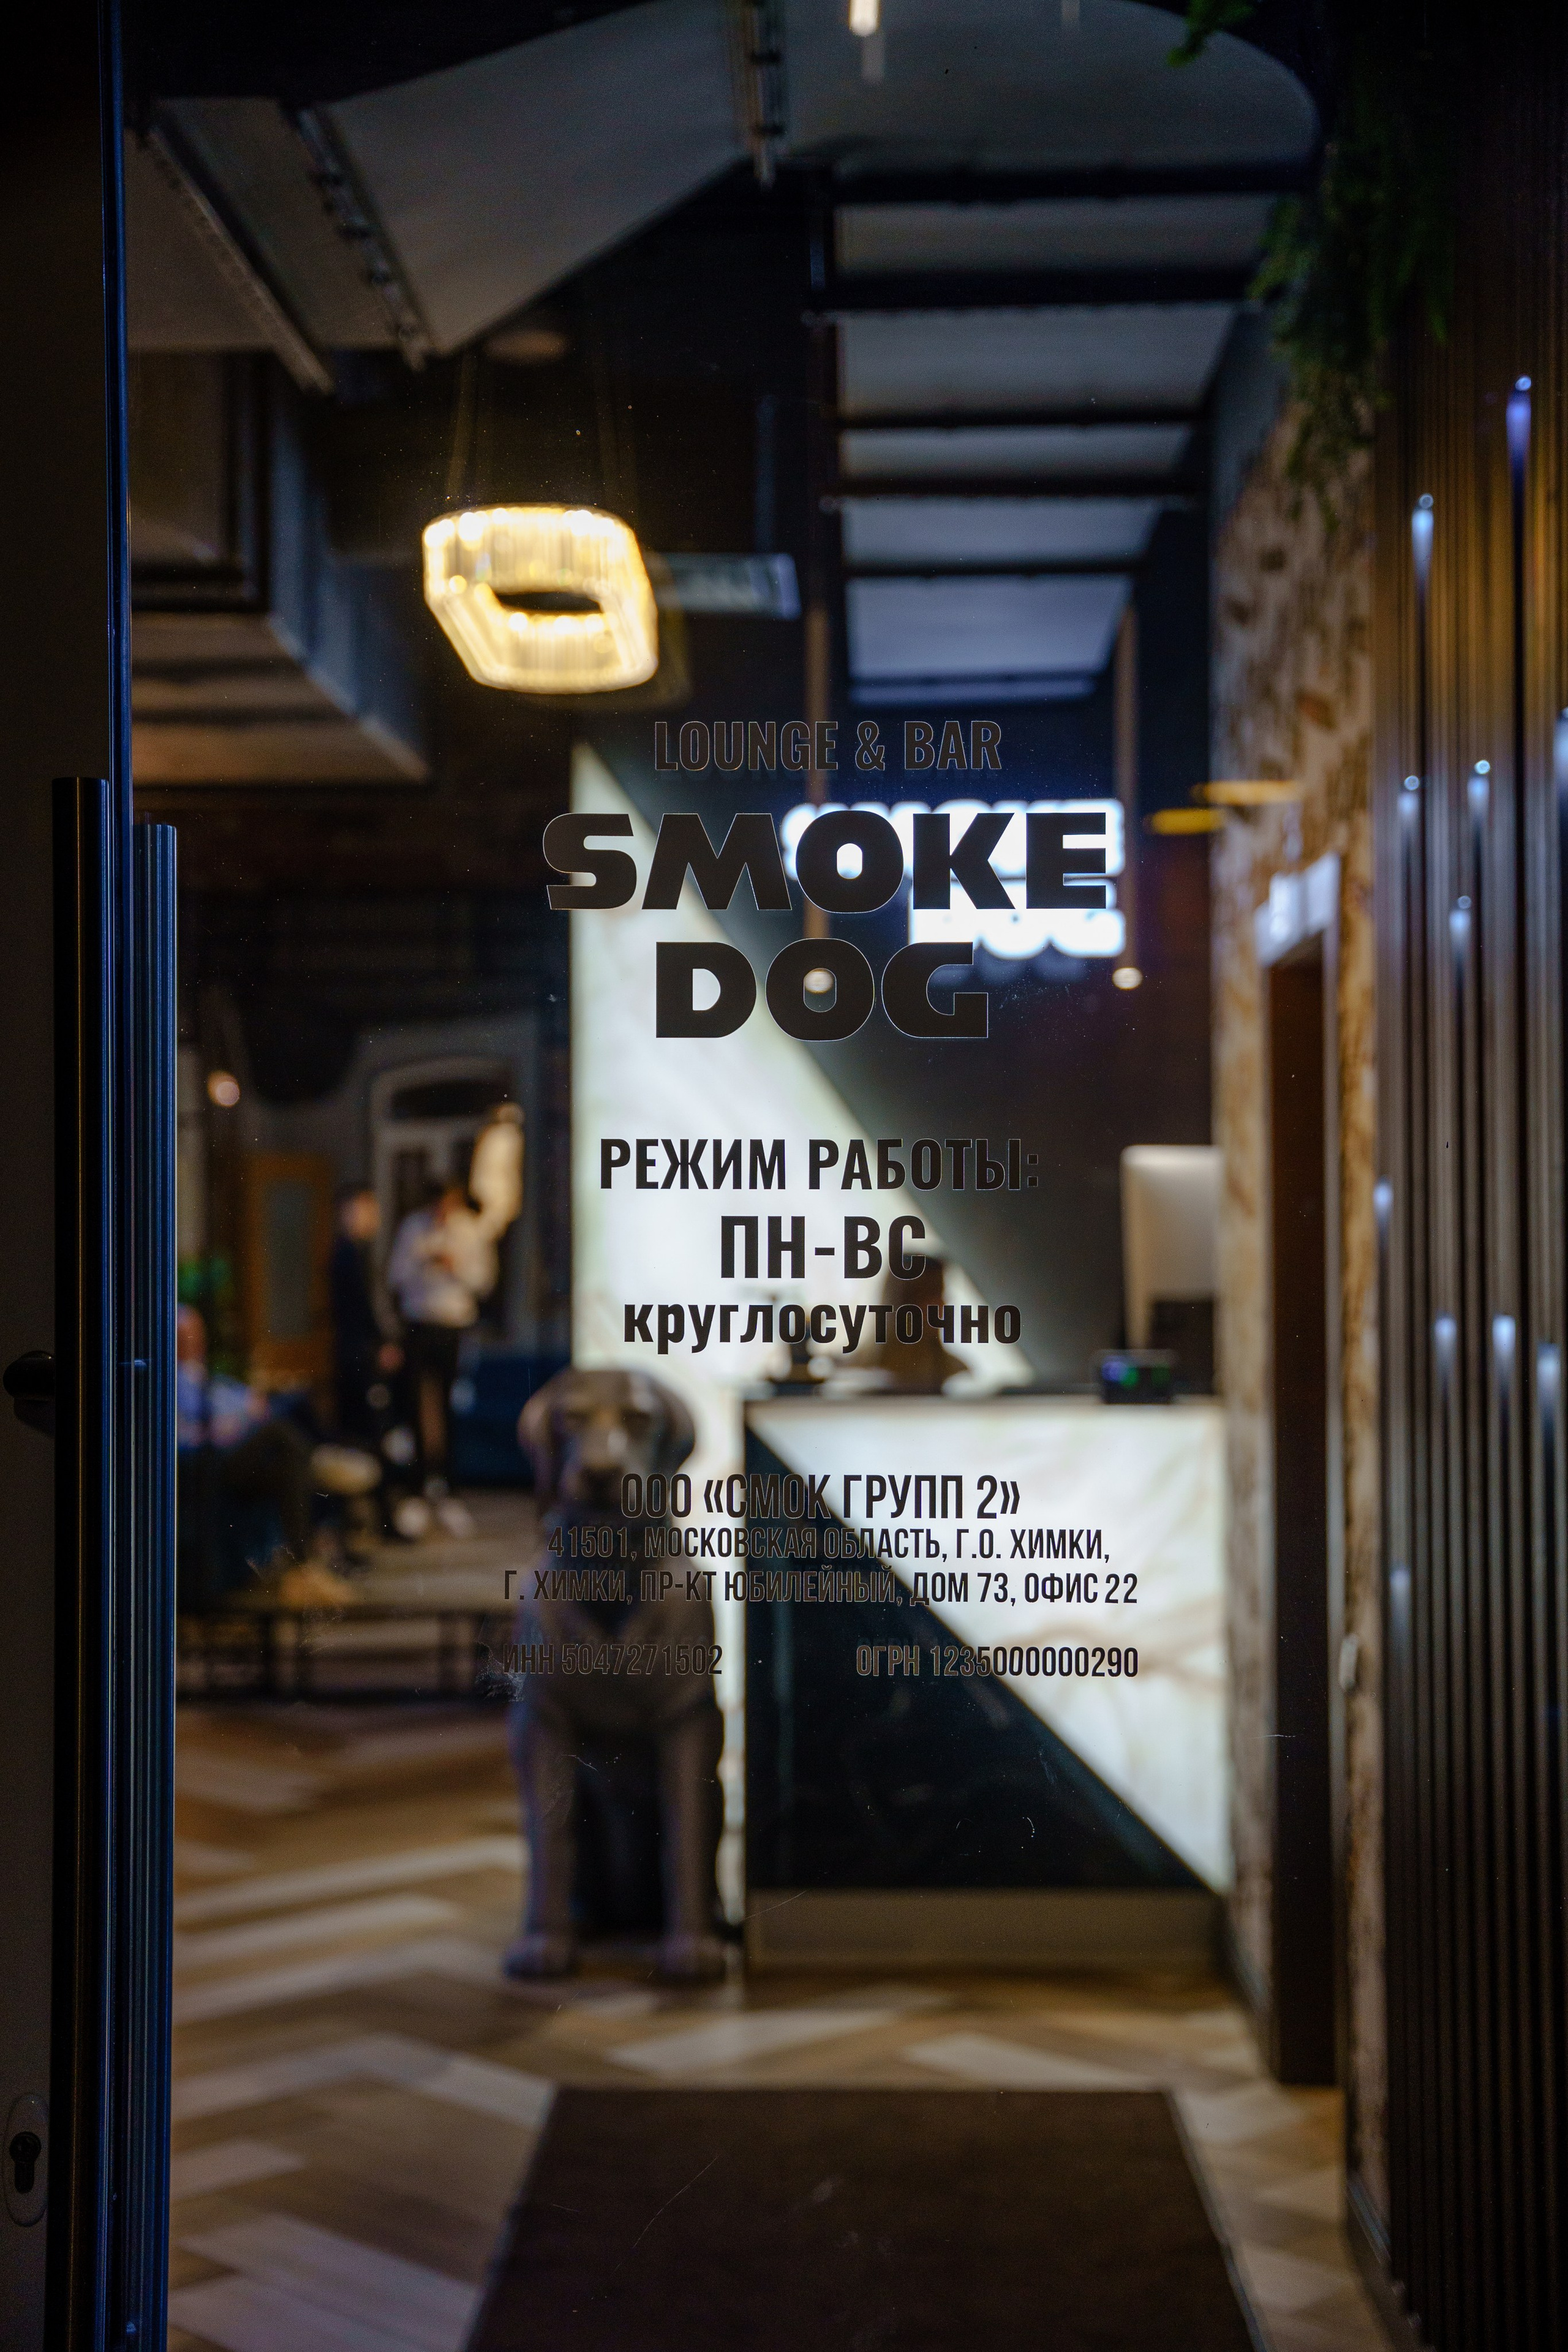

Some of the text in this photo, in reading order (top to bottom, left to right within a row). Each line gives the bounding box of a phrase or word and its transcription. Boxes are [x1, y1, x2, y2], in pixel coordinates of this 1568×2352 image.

[655, 720, 1002, 771] LOUNGE & BAR
[542, 809, 1107, 913] SMOKE
[656, 937, 989, 1041] DOG
[600, 1137, 1039, 1191] РЕЖИМ РАБОТЫ:
[720, 1215, 926, 1280] ПН-ВС
[624, 1303, 1021, 1354] круглосуточно
[620, 1474, 1020, 1519] ООО «СМОК ГРУПП 2»
[548, 1526, 1110, 1563] 41501, МОСКОВСКАЯ ОБЛАСТЬ, Г.О. ХИМКИ,
[504, 1564, 1138, 1607] Г. ХИМКИ, ПР-КТ ЮБИЛЕЙНЫЙ, ДОМ 73, ОФИС 22
[503, 1643, 723, 1675] ИНН 5047271502
[856, 1645, 1139, 1677] ОГРН 1235000000290
